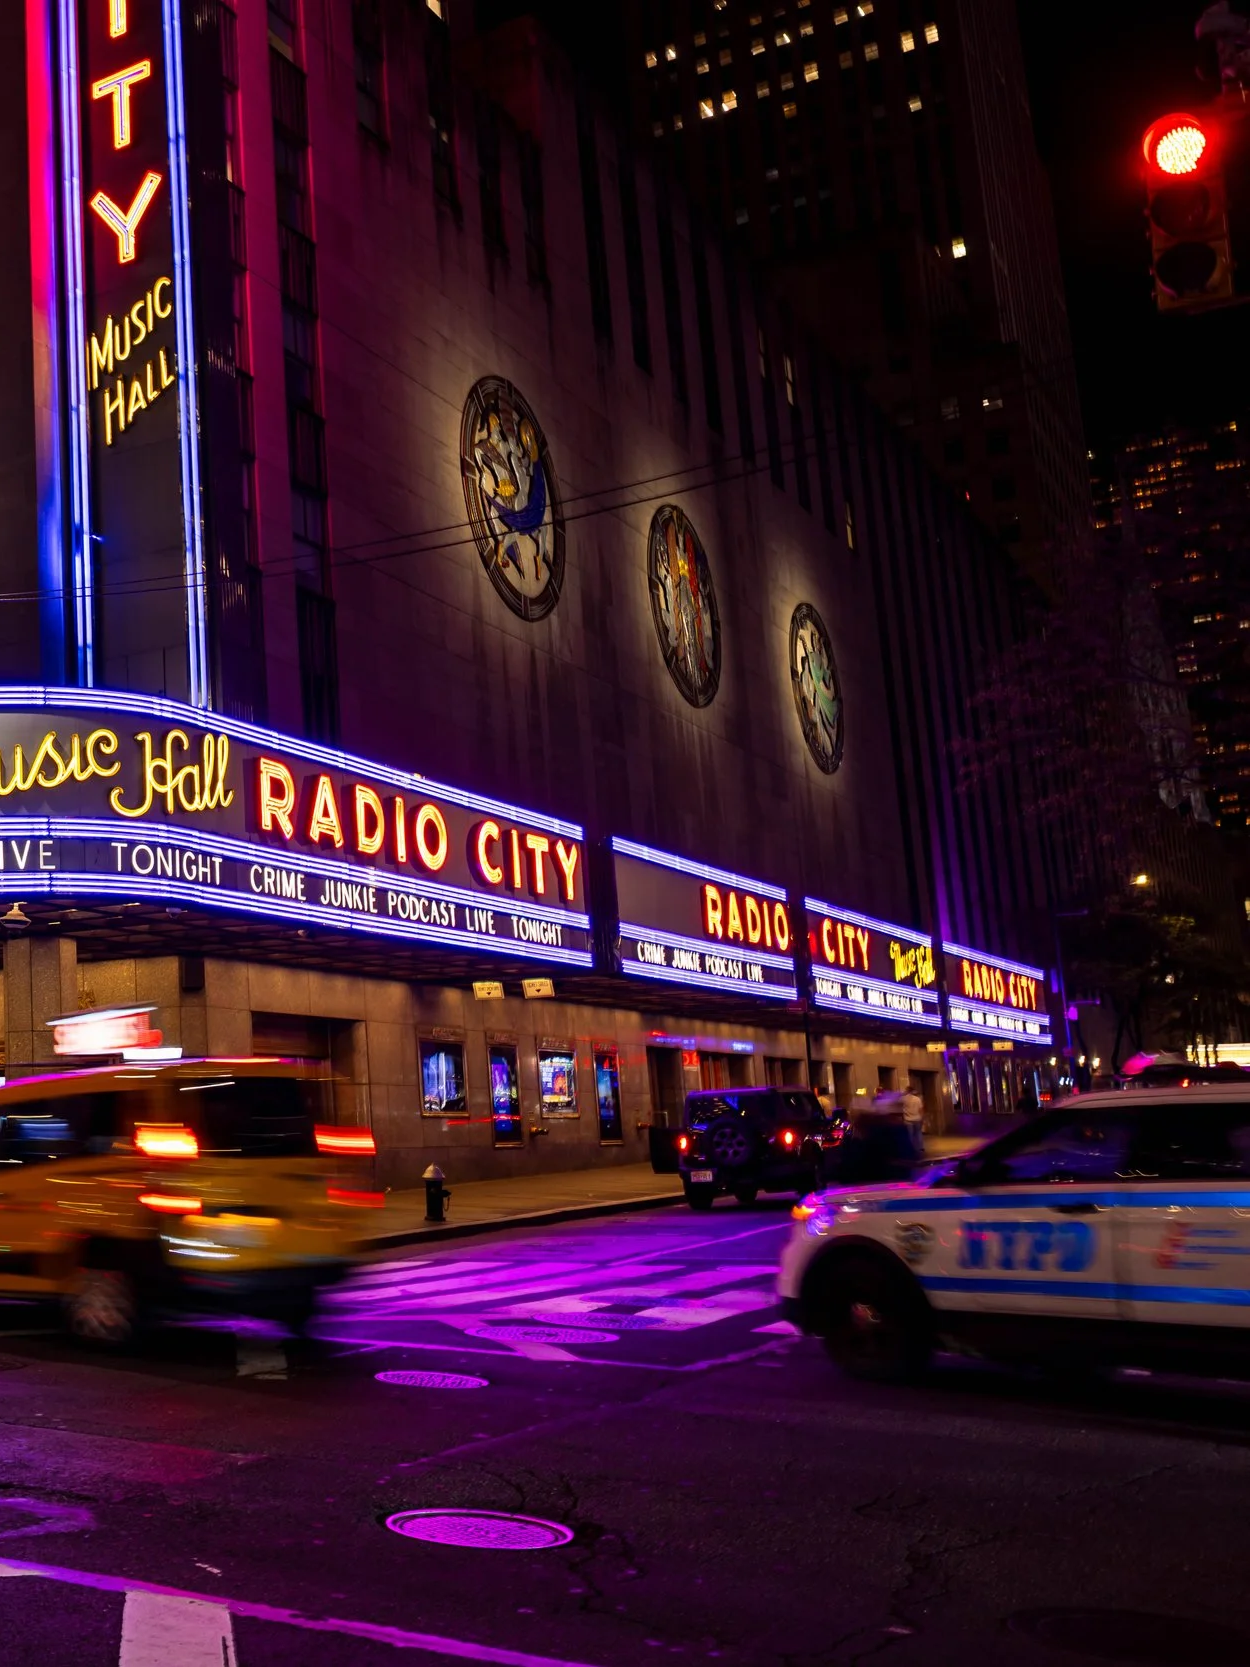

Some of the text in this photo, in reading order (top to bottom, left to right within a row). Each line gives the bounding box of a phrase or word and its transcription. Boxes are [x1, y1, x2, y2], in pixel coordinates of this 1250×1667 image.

[90, 0, 163, 264] ITY
[90, 276, 172, 390] MUSIC
[104, 348, 176, 446] HALL
[109, 728, 235, 818] Hall
[259, 756, 580, 901] RADIO CITY
[110, 842, 223, 886] TONIGHT
[250, 864, 307, 902] CRIME
[320, 878, 378, 914] JUNKIE
[387, 890, 456, 928] PODCAST
[465, 907, 497, 936] LIVE
[510, 914, 563, 947] TONIGHT
[704, 884, 790, 951] RADIO
[637, 940, 765, 983] CRIME JUNKIE PODCAST LIVE
[822, 918, 869, 971] CITY
[961, 959, 1037, 1011] RADIO CITY
